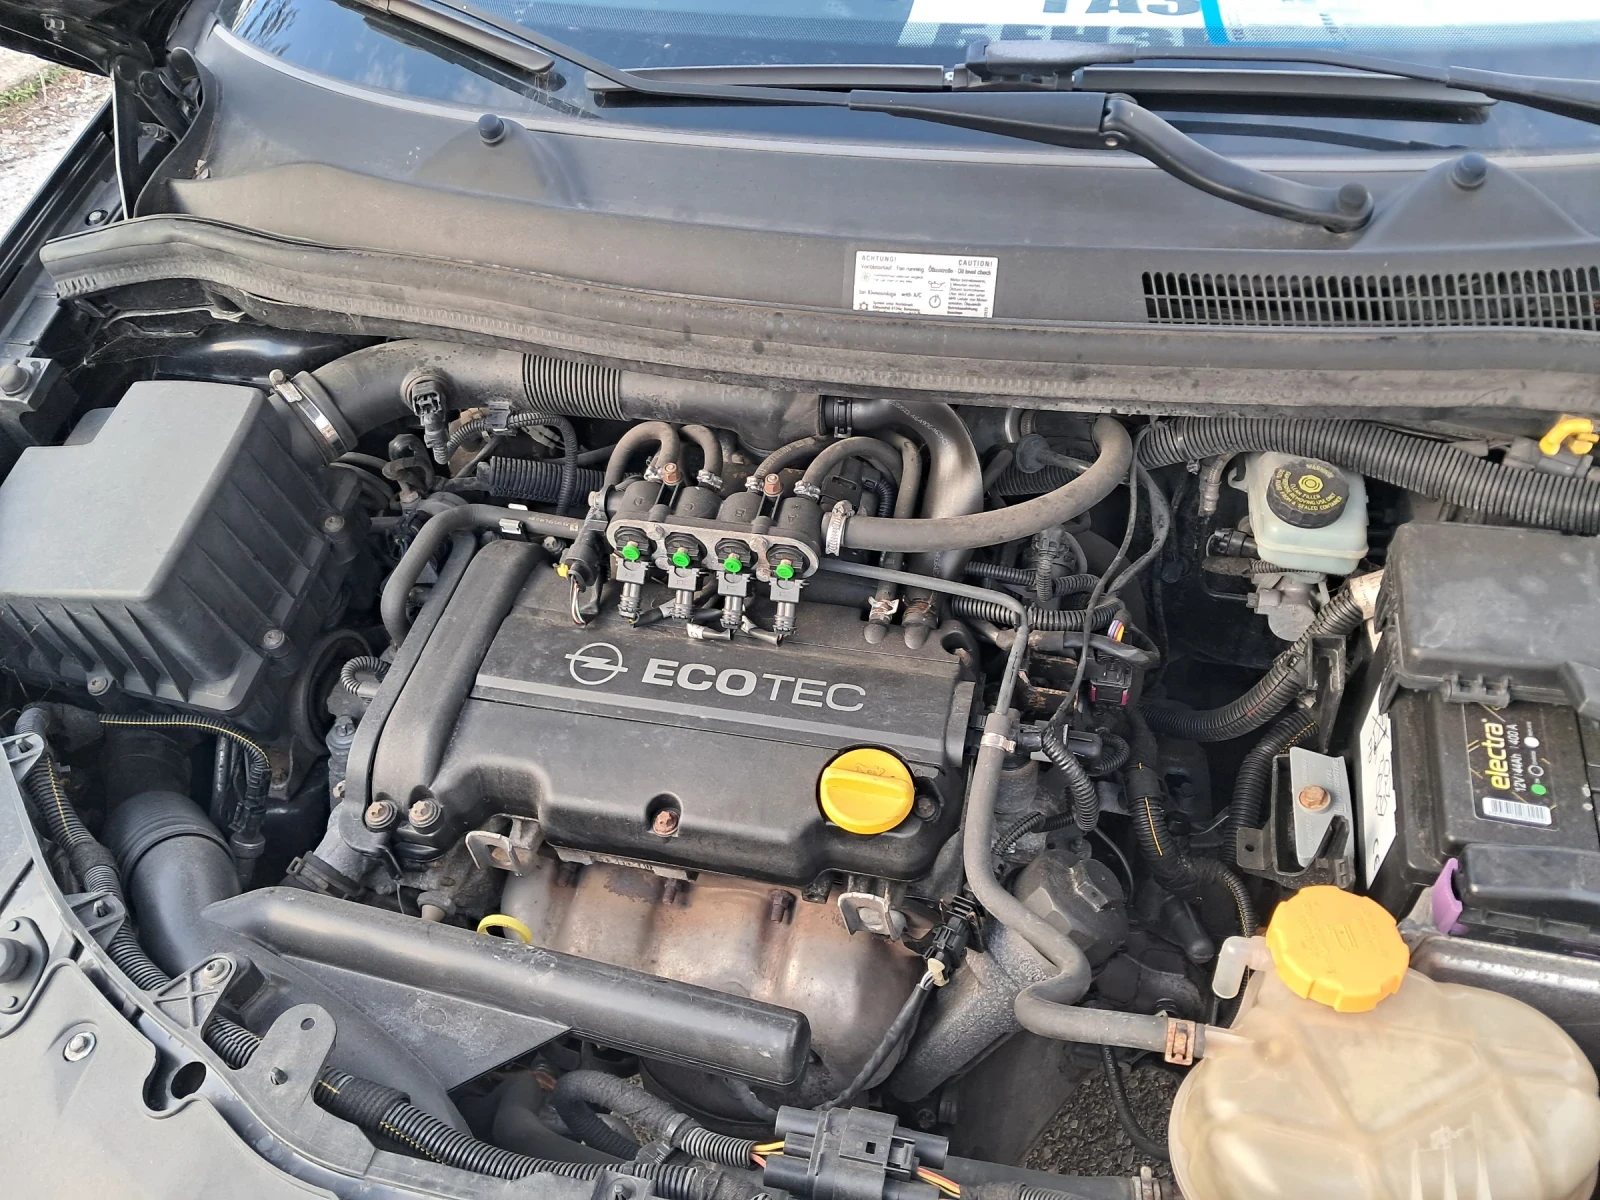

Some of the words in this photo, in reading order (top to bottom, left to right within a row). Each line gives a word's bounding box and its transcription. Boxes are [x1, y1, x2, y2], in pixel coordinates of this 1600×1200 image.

[861, 254, 897, 263] ACHTUNG!
[958, 259, 993, 268] CAUTION!
[1305, 463, 1335, 479] WARNING
[1297, 503, 1319, 511] SEALED
[641, 657, 866, 712] ECOTEC
[1481, 722, 1511, 790] electra
